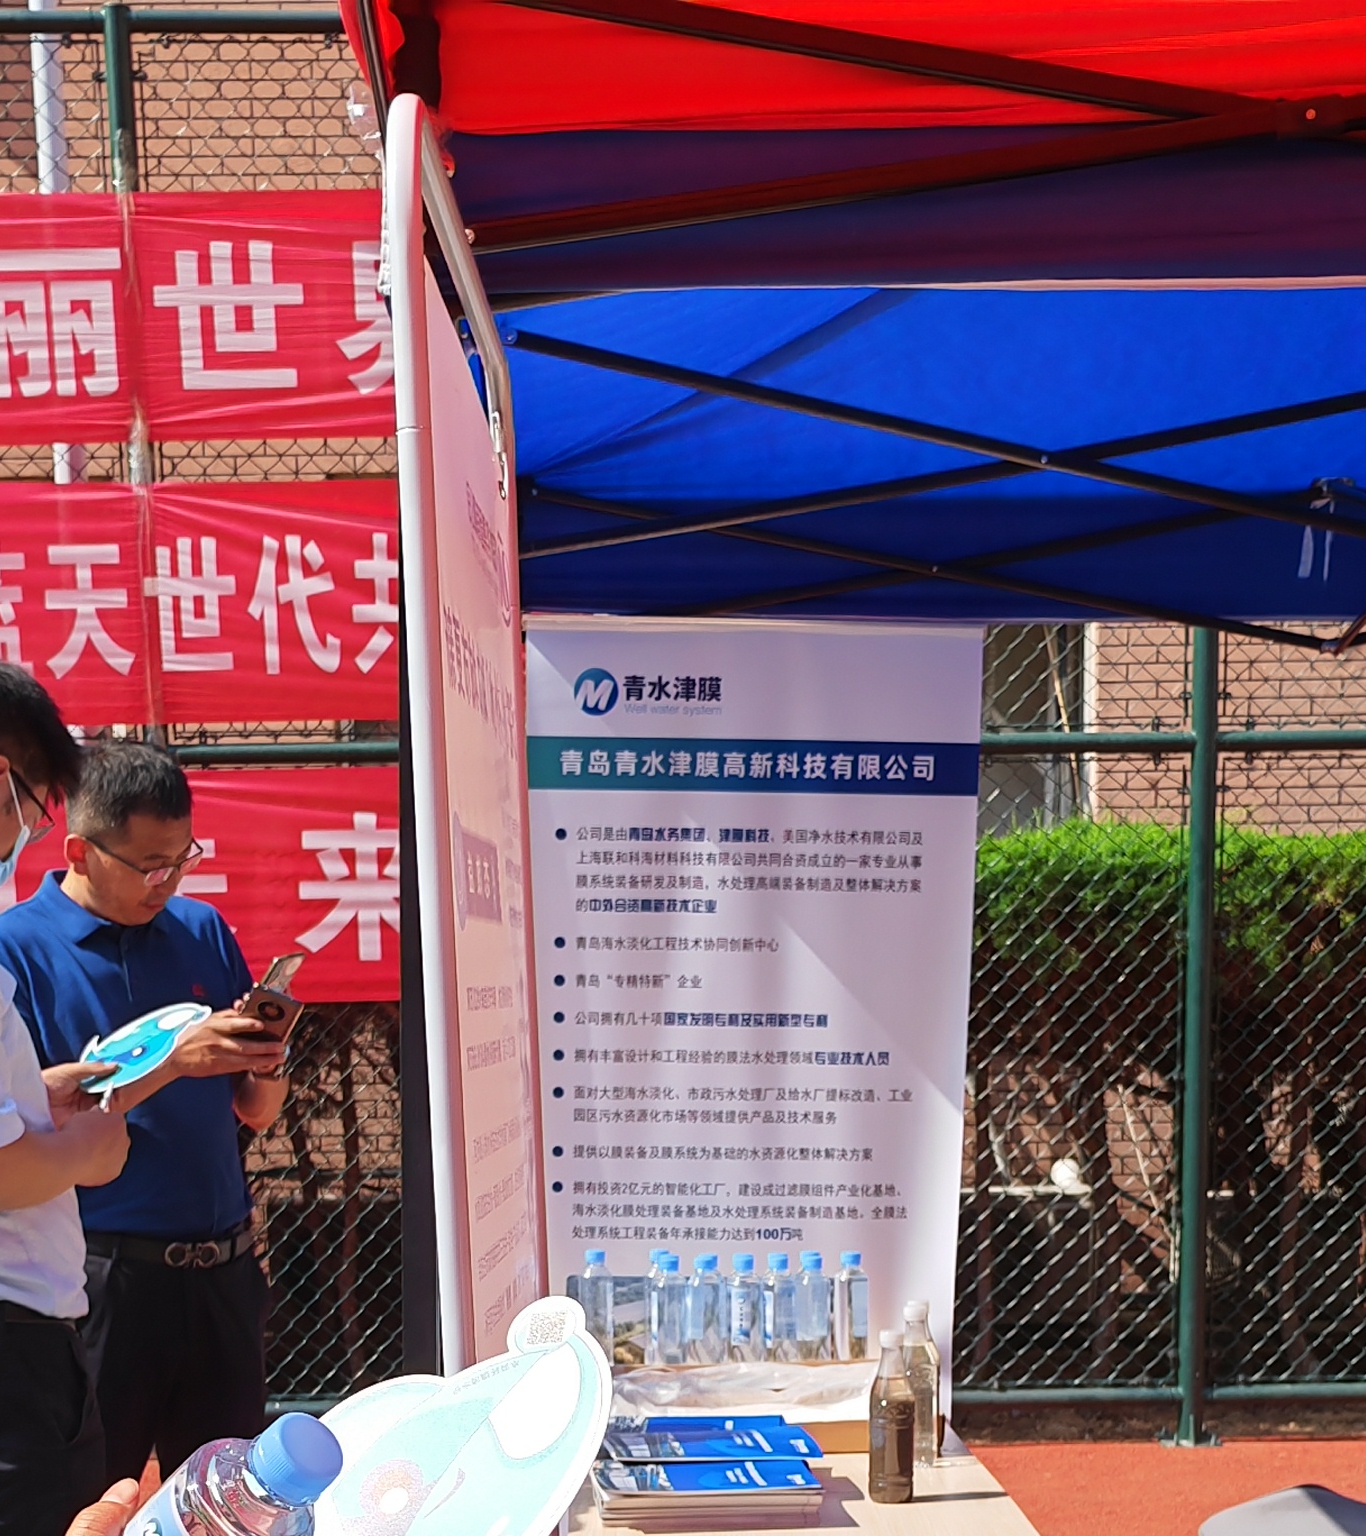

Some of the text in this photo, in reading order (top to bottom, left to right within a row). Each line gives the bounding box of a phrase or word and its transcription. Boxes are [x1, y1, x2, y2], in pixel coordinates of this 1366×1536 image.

[623, 675, 722, 703] 青水津膜
[560, 750, 936, 782] 青岛青水津膜高新科技有限公司
